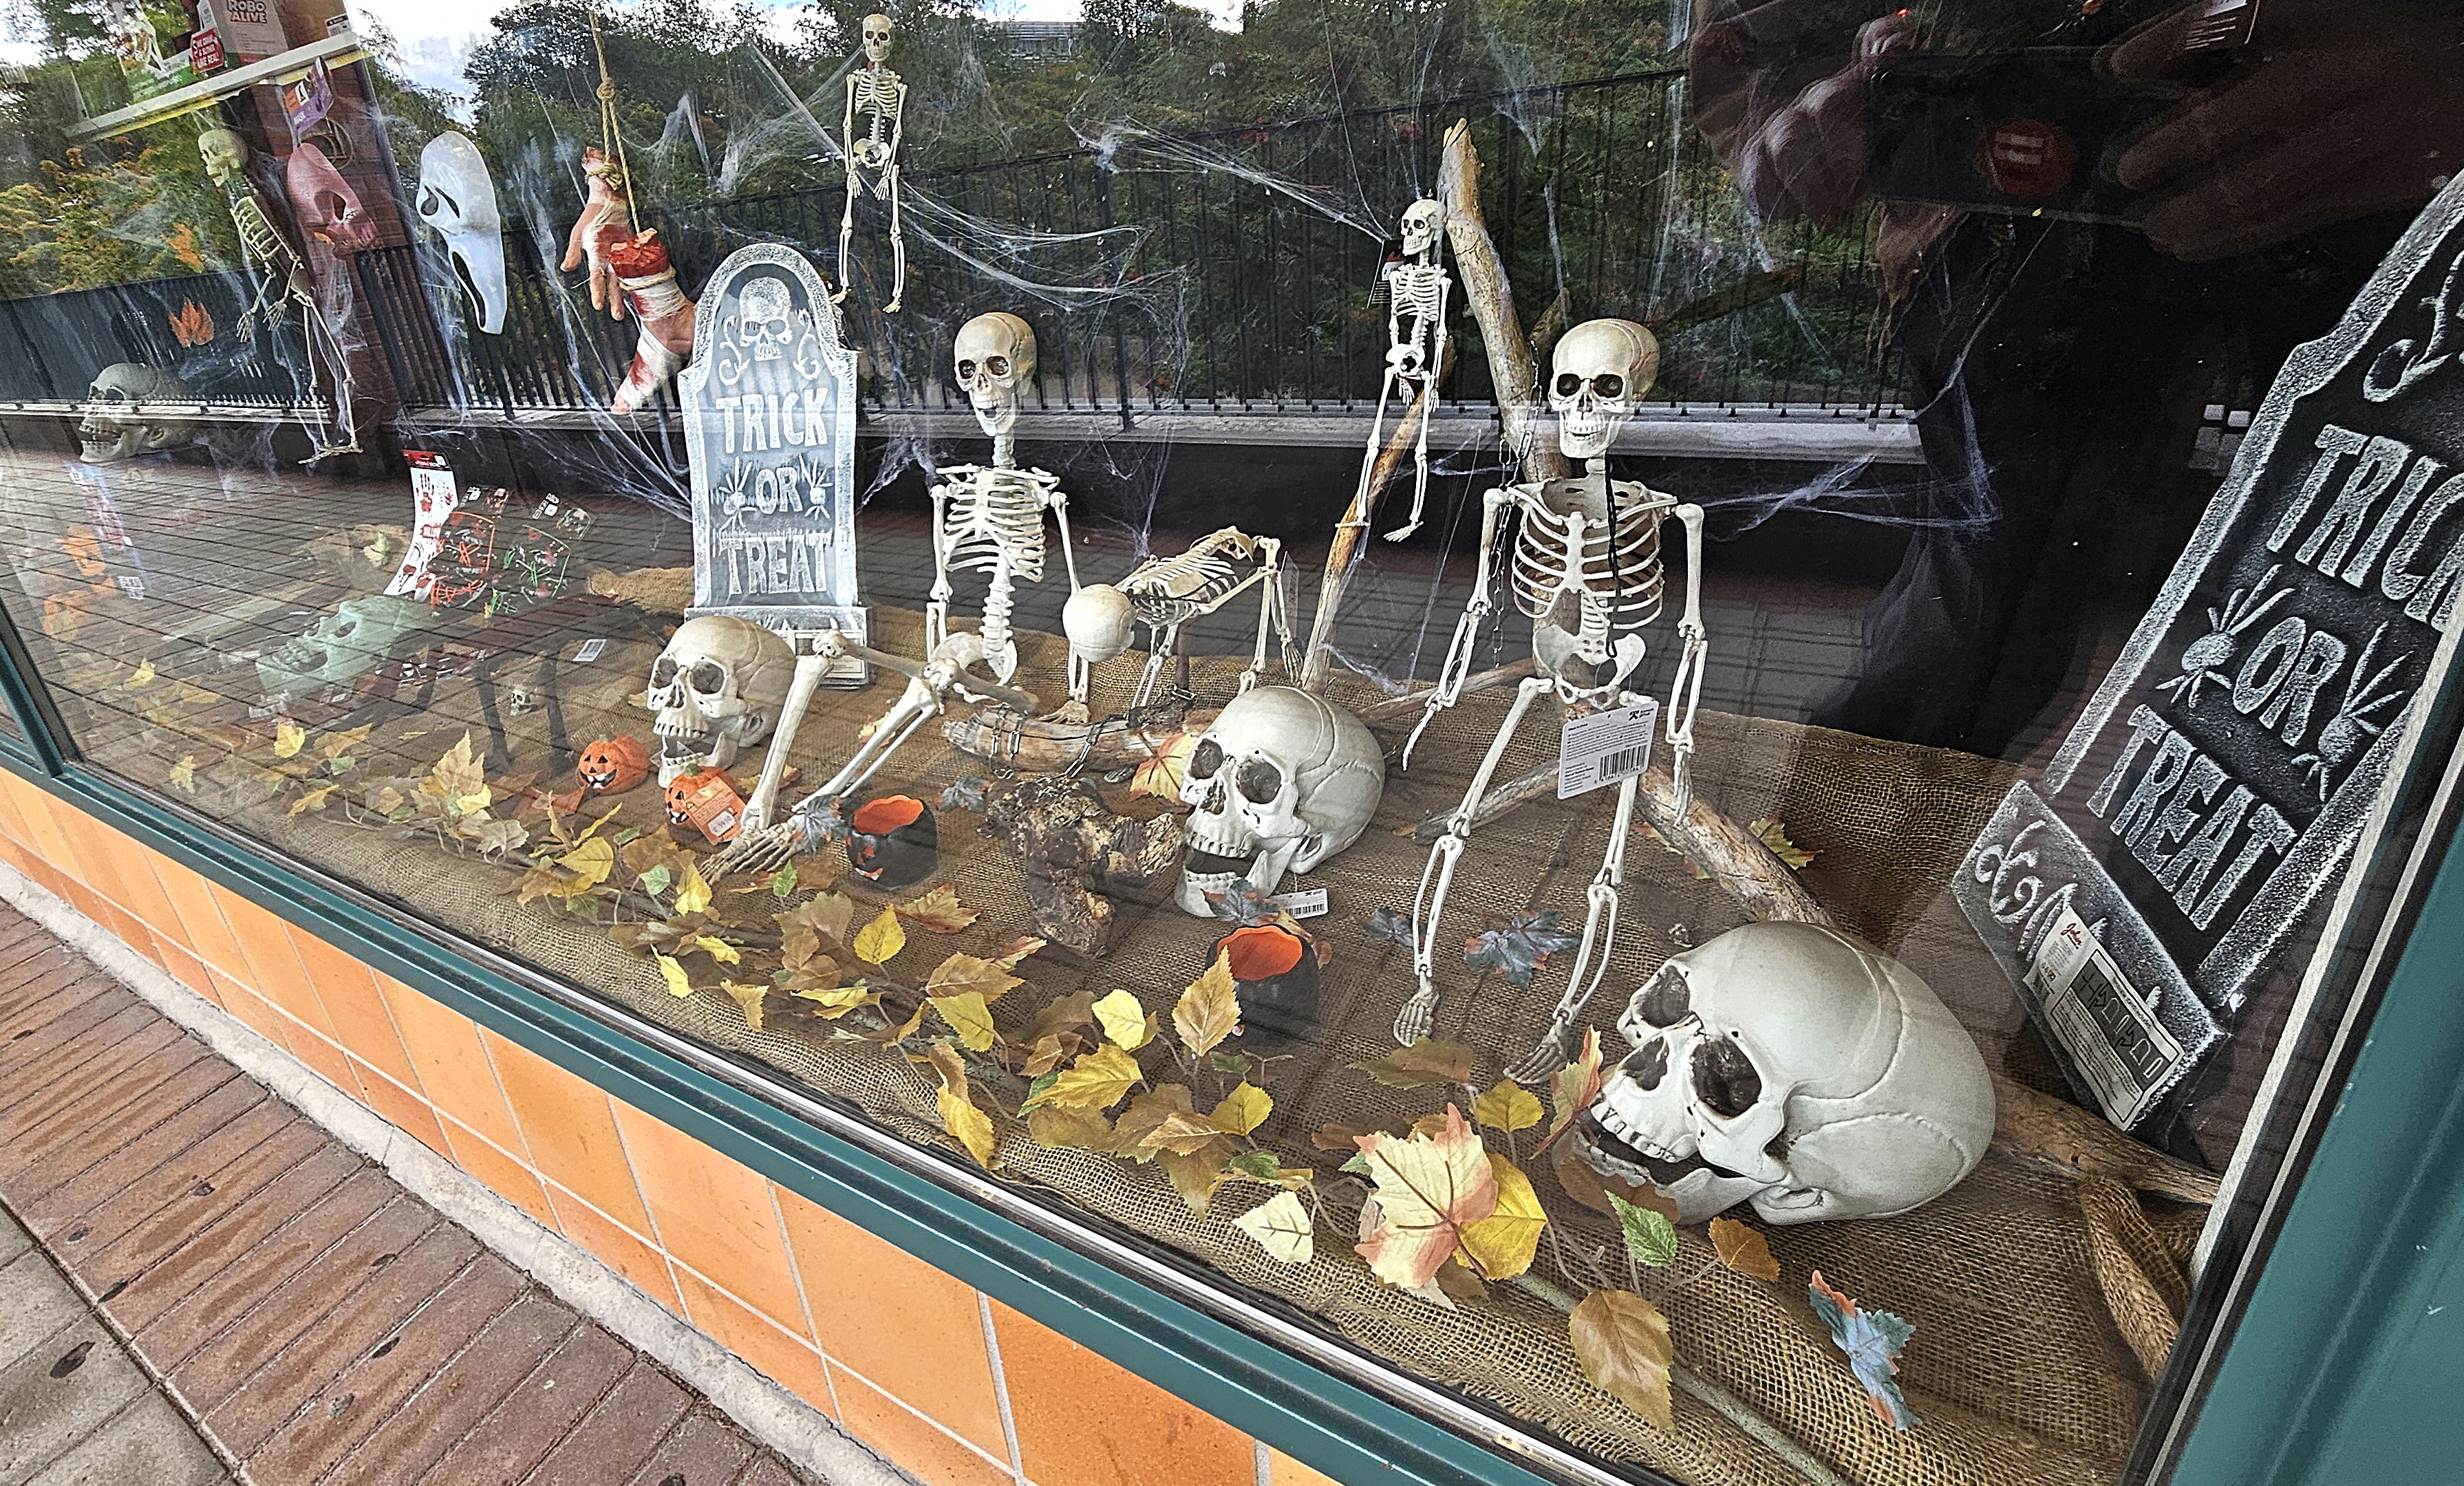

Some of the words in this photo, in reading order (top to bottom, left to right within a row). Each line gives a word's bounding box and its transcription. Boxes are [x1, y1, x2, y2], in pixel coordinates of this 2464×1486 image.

[228, 0, 266, 12] ROBO
[231, 12, 267, 23] ALIVE
[716, 387, 828, 454] TRICK
[755, 467, 803, 514] OR
[720, 531, 832, 594] TREAT
[2233, 616, 2348, 747] OR
[2086, 704, 2298, 931] TREAT
